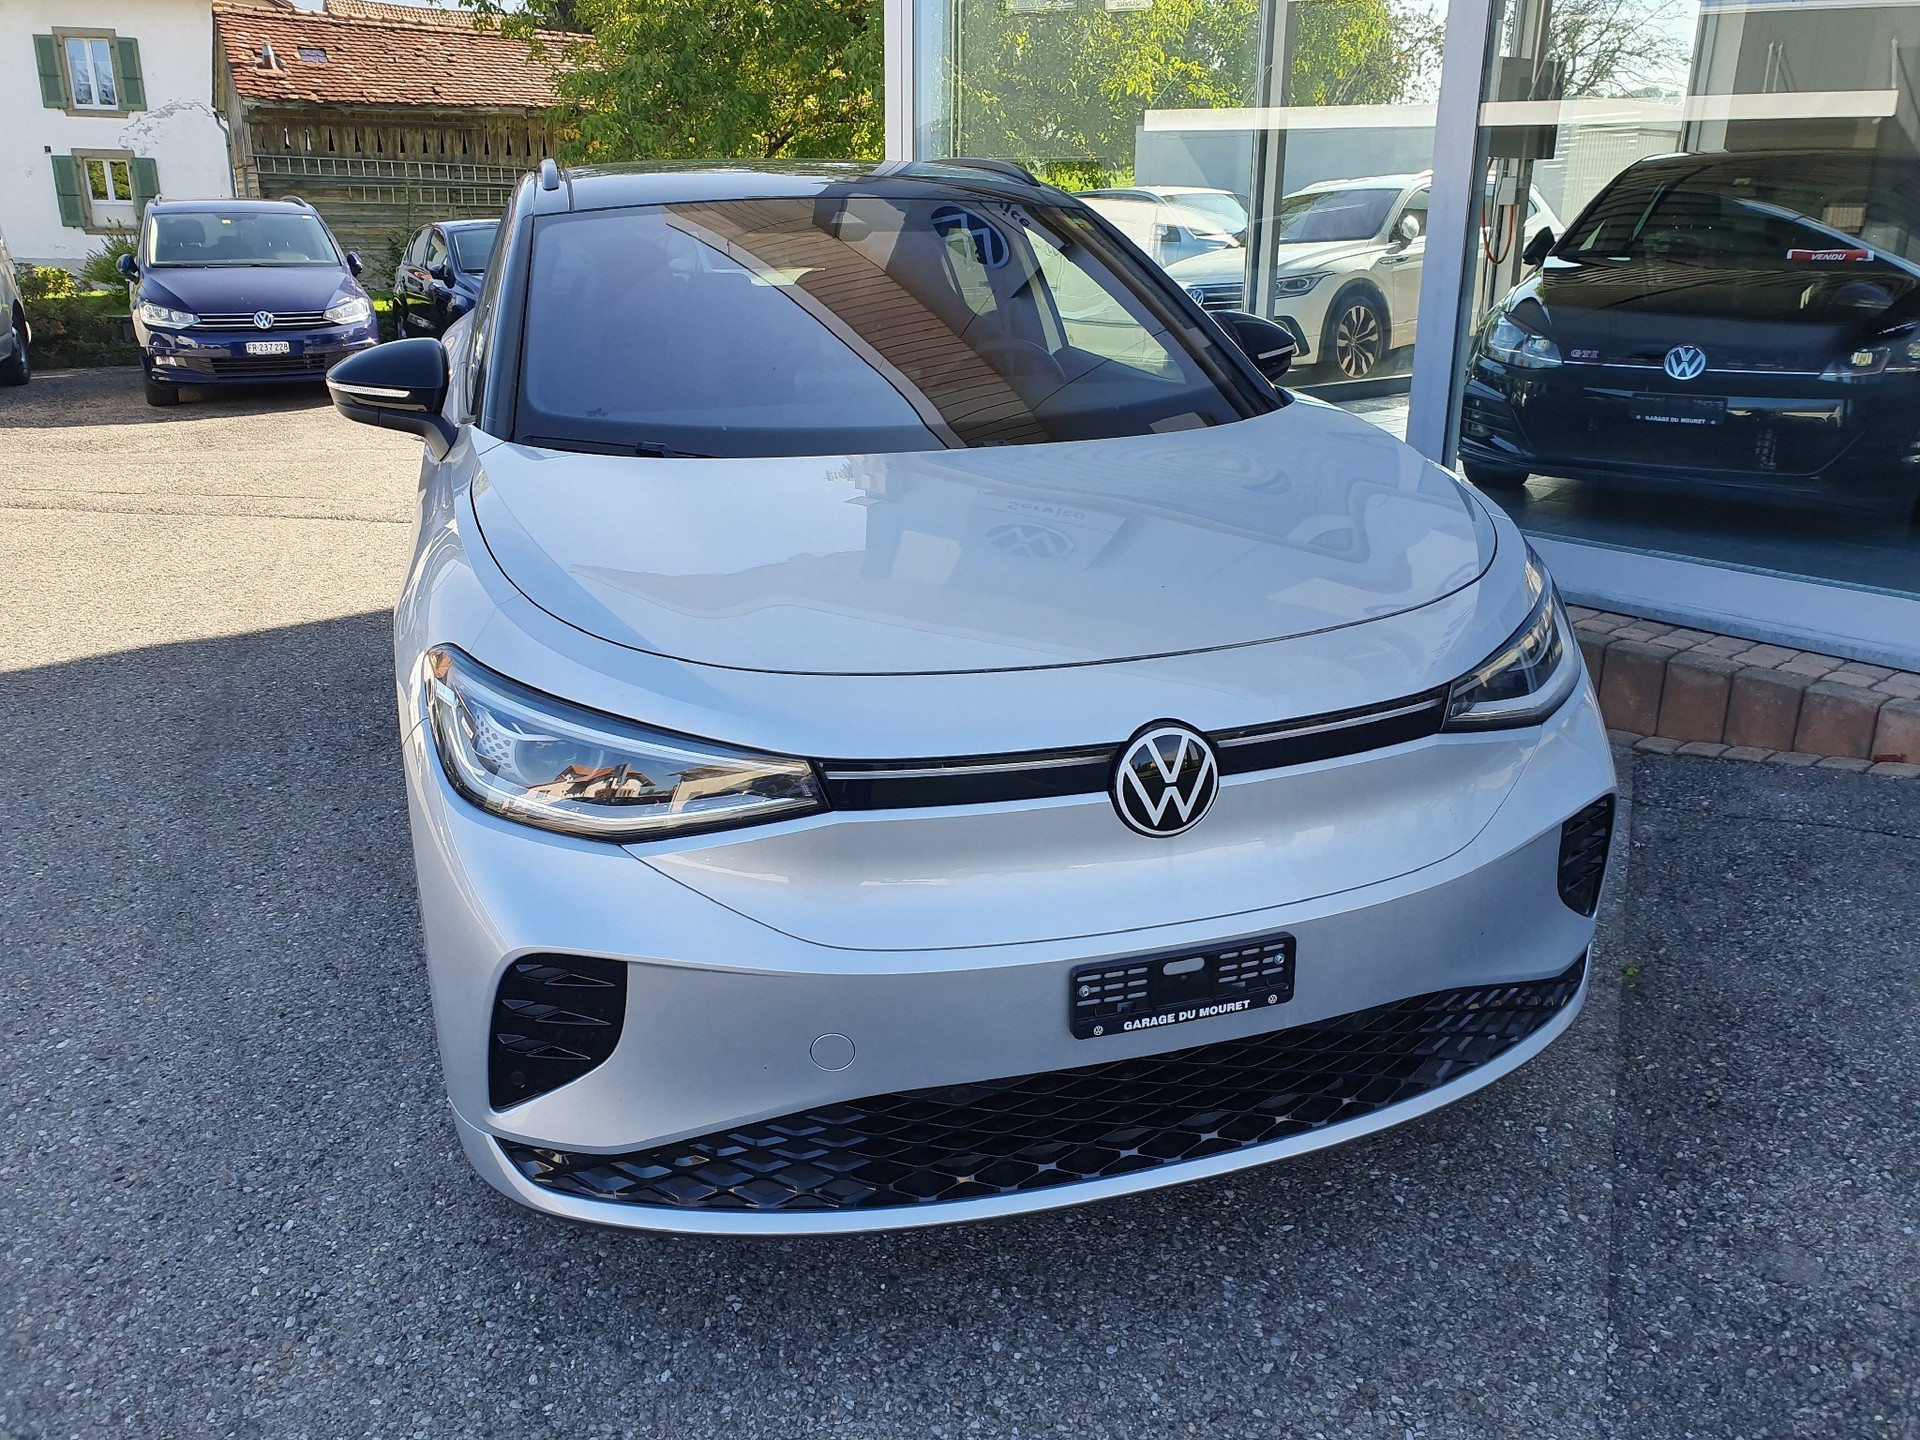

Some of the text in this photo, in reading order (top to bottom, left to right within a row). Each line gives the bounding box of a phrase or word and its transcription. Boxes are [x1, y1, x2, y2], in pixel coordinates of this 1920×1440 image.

[1811, 253, 1847, 261] VENDU
[1570, 348, 1600, 359] GTI
[1644, 415, 1670, 423] GARAGE
[1123, 999, 1251, 1031] GARAGE DU MOURET
